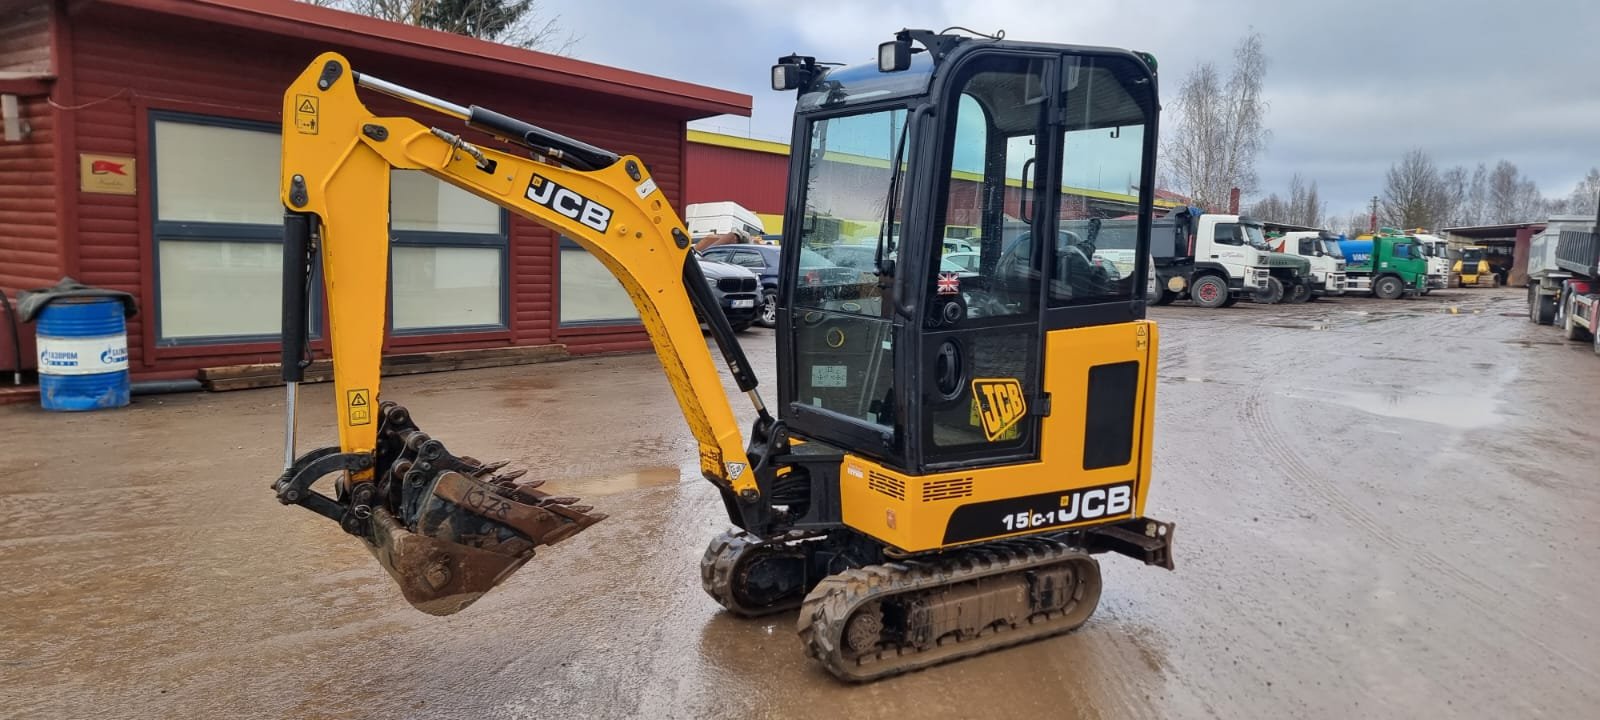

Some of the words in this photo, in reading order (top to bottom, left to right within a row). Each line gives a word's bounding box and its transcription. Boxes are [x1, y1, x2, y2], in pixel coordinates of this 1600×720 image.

[527, 181, 612, 232] JCB
[981, 383, 1023, 433] JCB
[463, 486, 512, 519] 1078
[1058, 485, 1131, 522] JCB
